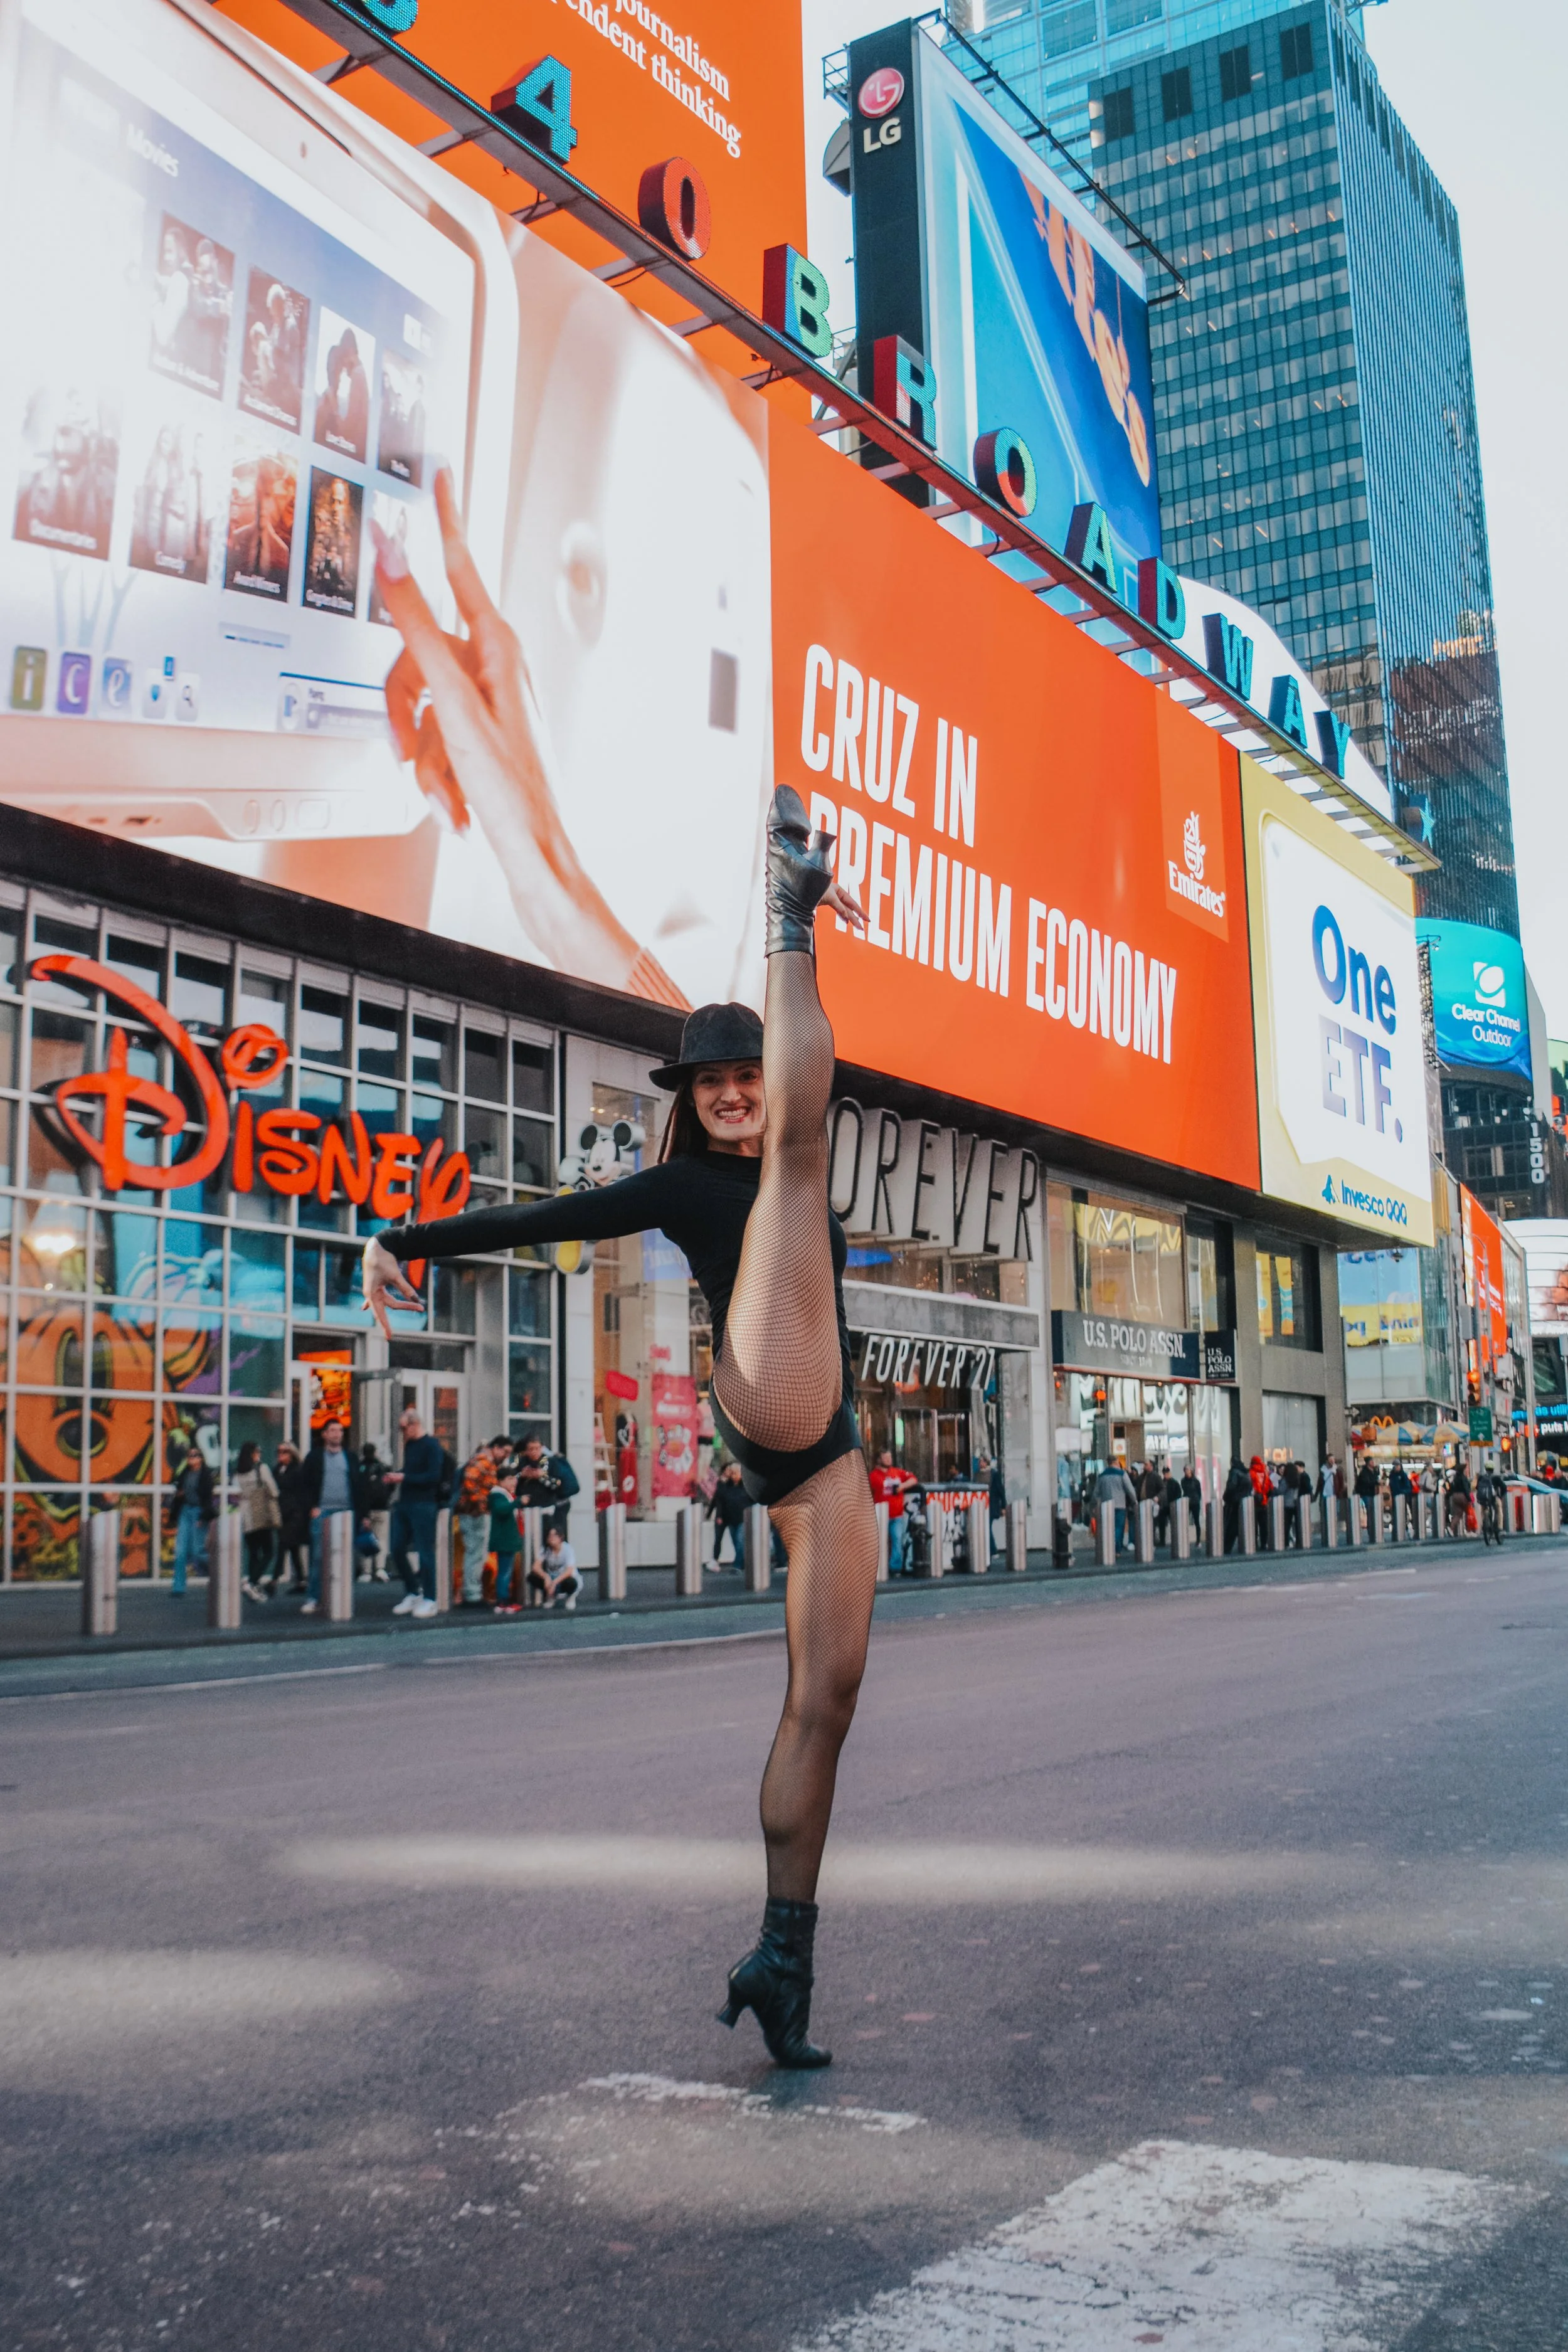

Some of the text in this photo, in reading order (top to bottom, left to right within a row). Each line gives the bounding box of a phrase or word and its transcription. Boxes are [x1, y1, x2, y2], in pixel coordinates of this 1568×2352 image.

[650, 53, 741, 158] thinking
[863, 117, 901, 154] LG
[763, 243, 1352, 779] BROADWAY
[801, 644, 978, 848] CRUZ IN
[1168, 860, 1225, 918] Emirates
[1026, 898, 1177, 1064] ECONOMY
[1312, 905, 1396, 1036] One
[1451, 1003, 1521, 1033] Clear Channel
[1472, 1025, 1512, 1047] Outdoor
[1319, 1014, 1403, 1143] ETF.
[1529, 1122, 1545, 1184] 1500
[1341, 1179, 1407, 1227] Invesco QQQ
[861, 1335, 995, 1391] FOREVER 21
[1083, 1320, 1186, 1359] U.S. POLO ASSN.
[1208, 1355, 1232, 1366] POLO
